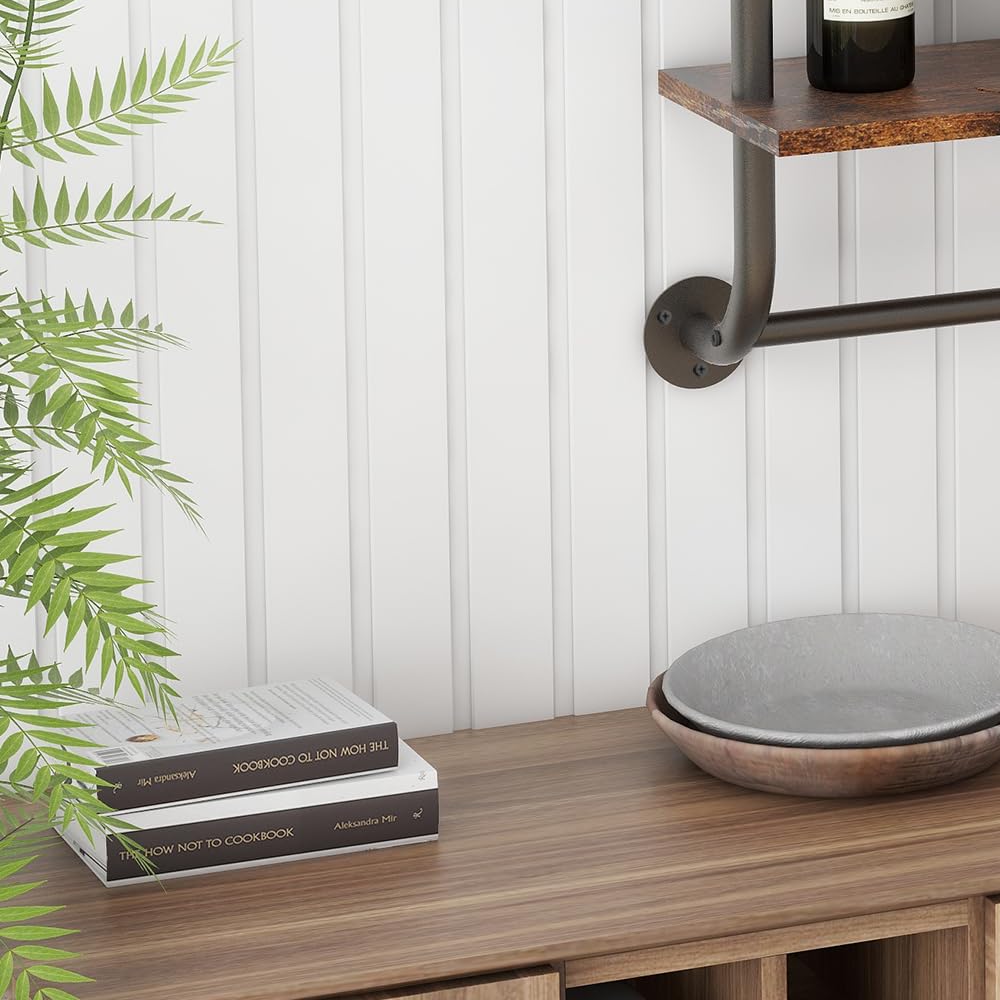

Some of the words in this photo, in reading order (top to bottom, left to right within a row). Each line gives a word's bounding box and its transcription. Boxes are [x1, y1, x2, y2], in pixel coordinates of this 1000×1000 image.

[853, 7, 889, 15] BOUTEILLE
[314, 746, 338, 761] NOT
[340, 742, 367, 756] HOW
[369, 740, 389, 753] THE
[232, 753, 296, 774] COOKBOOK
[297, 751, 314, 764] TO
[136, 776, 153, 788] Mir
[153, 769, 197, 784] Aleksandra
[333, 817, 380, 831] Aleksandra
[381, 813, 398, 825] Mir
[119, 849, 142, 861] TH
[143, 843, 174, 858] HOW
[177, 839, 204, 853] NOT
[206, 836, 222, 849] TO
[224, 826, 294, 846] COOKBOOK
